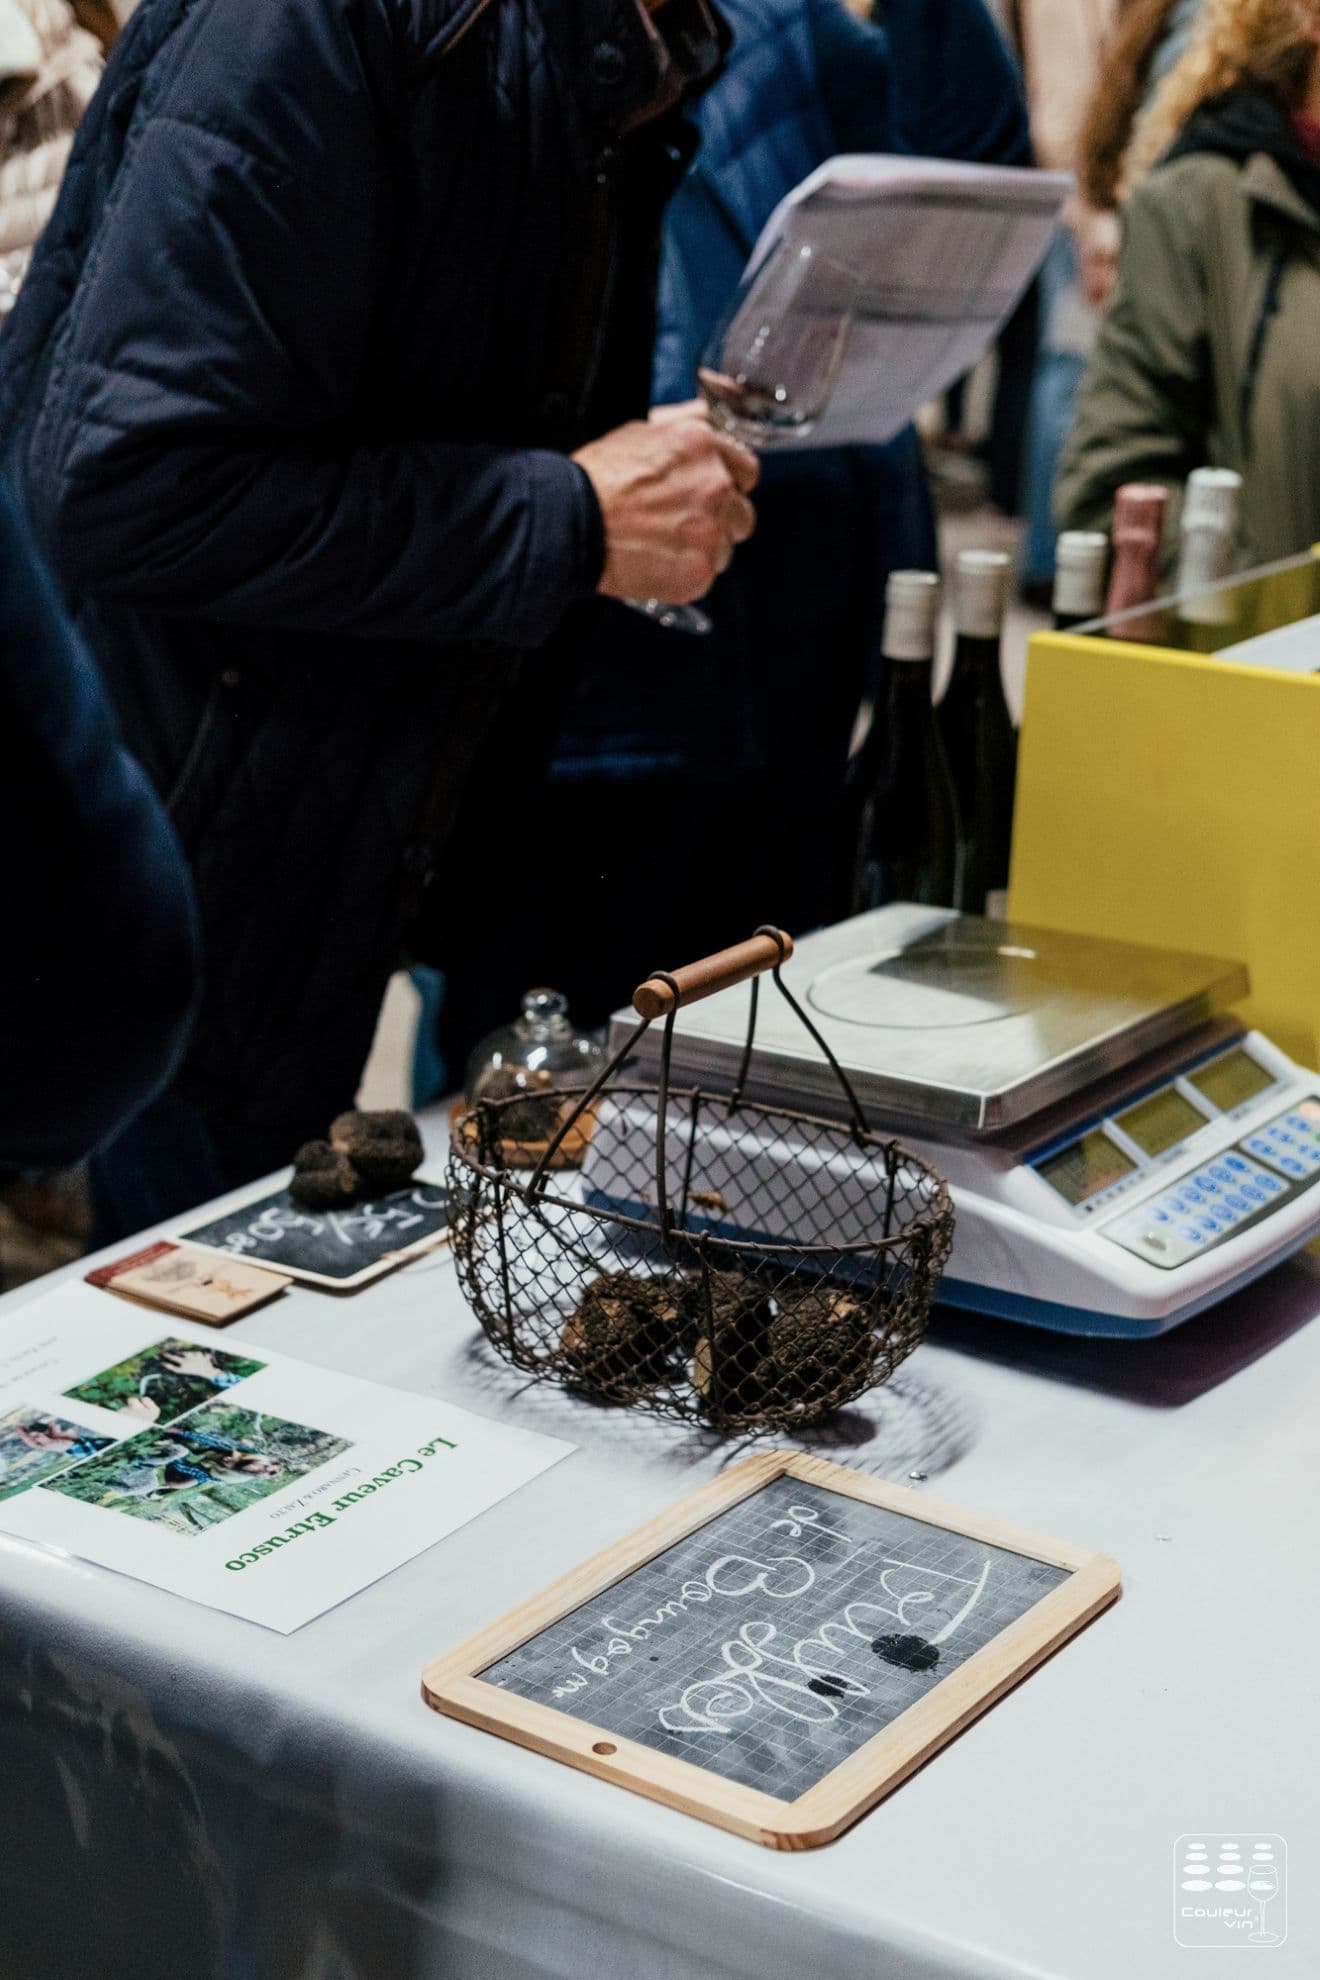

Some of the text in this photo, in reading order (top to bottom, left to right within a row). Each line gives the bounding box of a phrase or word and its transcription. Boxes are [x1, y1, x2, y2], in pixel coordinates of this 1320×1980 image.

[224, 1436, 458, 1571] Le Caveur Etrusco
[552, 1505, 854, 1699] de Bourgogne
[662, 1559, 992, 1734] Truffes
